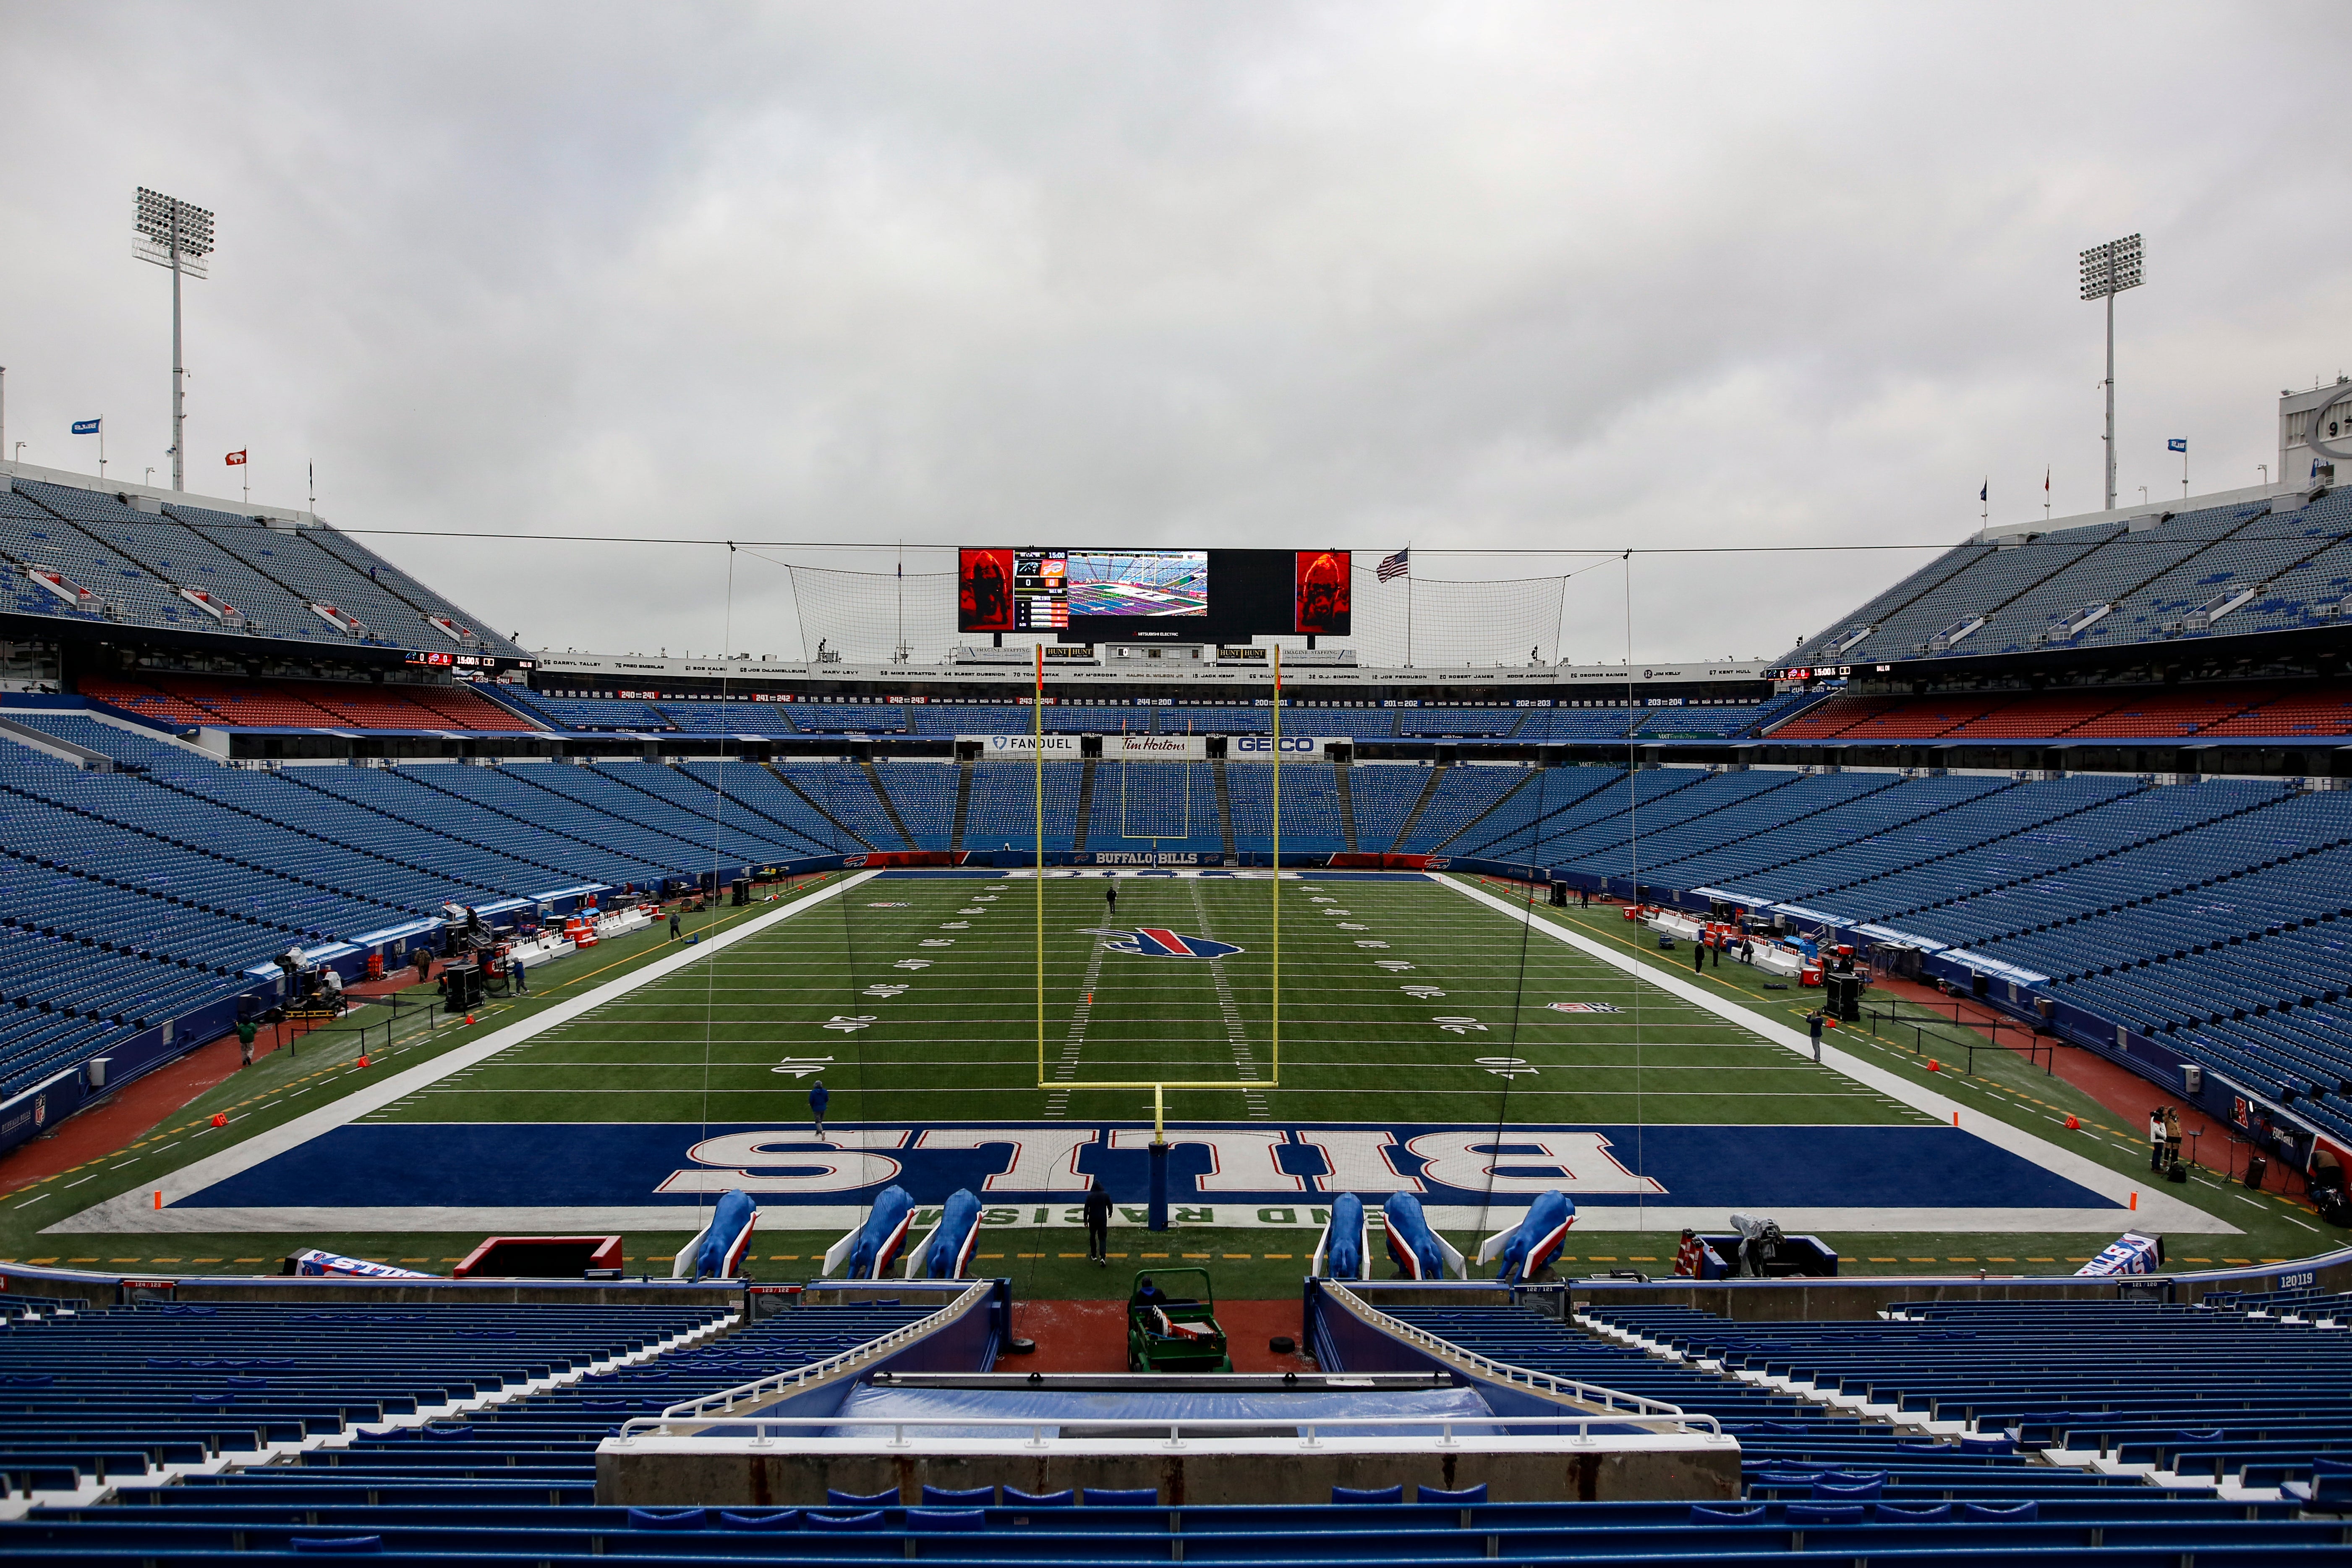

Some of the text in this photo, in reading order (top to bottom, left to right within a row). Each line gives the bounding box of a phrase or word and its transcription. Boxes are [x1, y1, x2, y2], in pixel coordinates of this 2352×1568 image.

[2330, 422, 2338, 436] 9
[457, 656, 474, 665] 15:00
[1011, 739, 1072, 748] FANDUEL
[1122, 737, 1185, 751] Tim Hortons
[1238, 738, 1314, 751] GEICO
[1096, 853, 1151, 864] BUFFALO
[1158, 853, 1198, 864] BILLS
[771, 1056, 834, 1073] 10
[1474, 1057, 1540, 1075] 10
[219, 1115, 226, 1124] G
[2066, 1117, 2074, 1127] G
[652, 1129, 1670, 1194] BILLS
